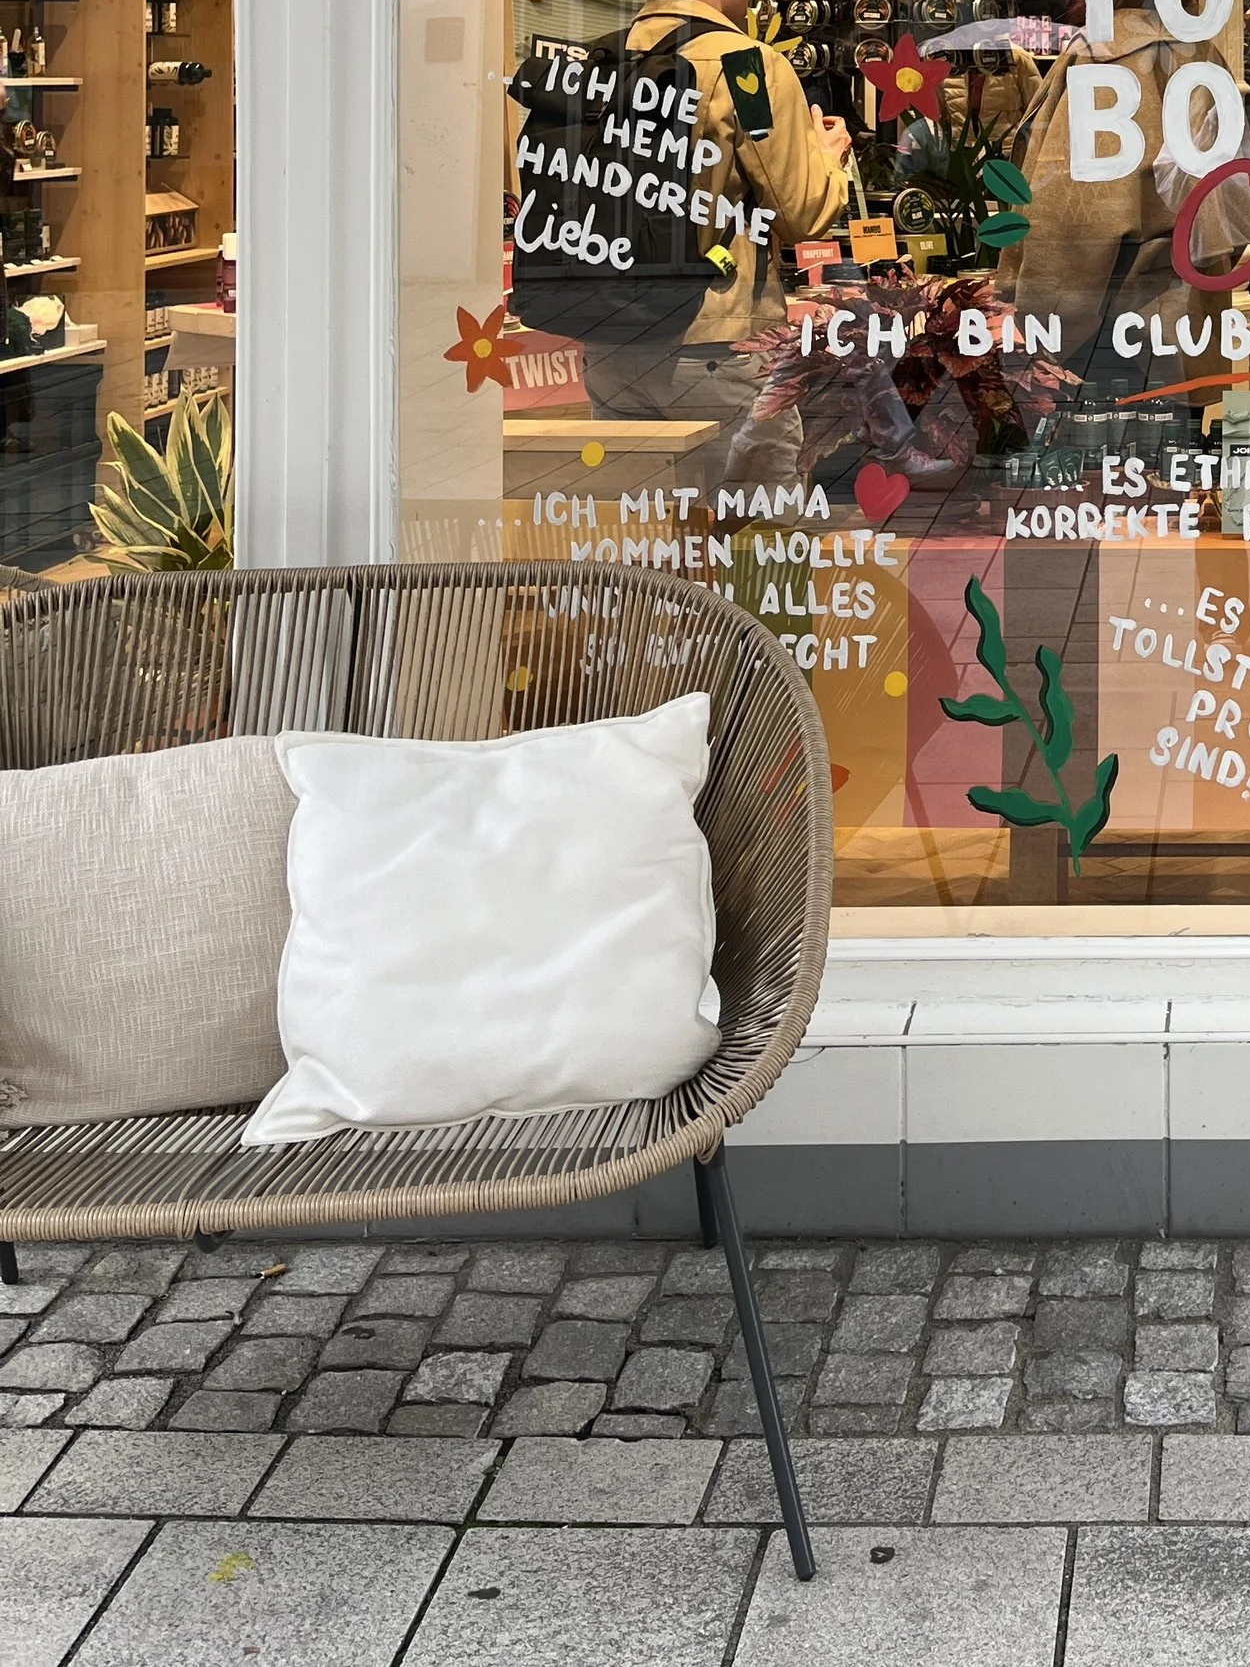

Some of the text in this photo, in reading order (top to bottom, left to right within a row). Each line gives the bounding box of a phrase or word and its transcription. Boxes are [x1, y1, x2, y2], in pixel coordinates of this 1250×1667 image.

[535, 39, 590, 62] IT'S
[632, 77, 703, 125] DIE
[603, 113, 722, 174] HEMP
[515, 135, 776, 246] HANDCREME
[513, 189, 635, 271] Liebe
[801, 311, 904, 358] ICH
[958, 309, 1061, 355] BIN
[506, 350, 577, 389] TWIST
[620, 488, 699, 524] MIT
[717, 483, 831, 522] MAMA
[1006, 501, 1201, 541] KORREKTE
[755, 529, 898, 568] WOLLTE
[759, 581, 876, 620] ALLES
